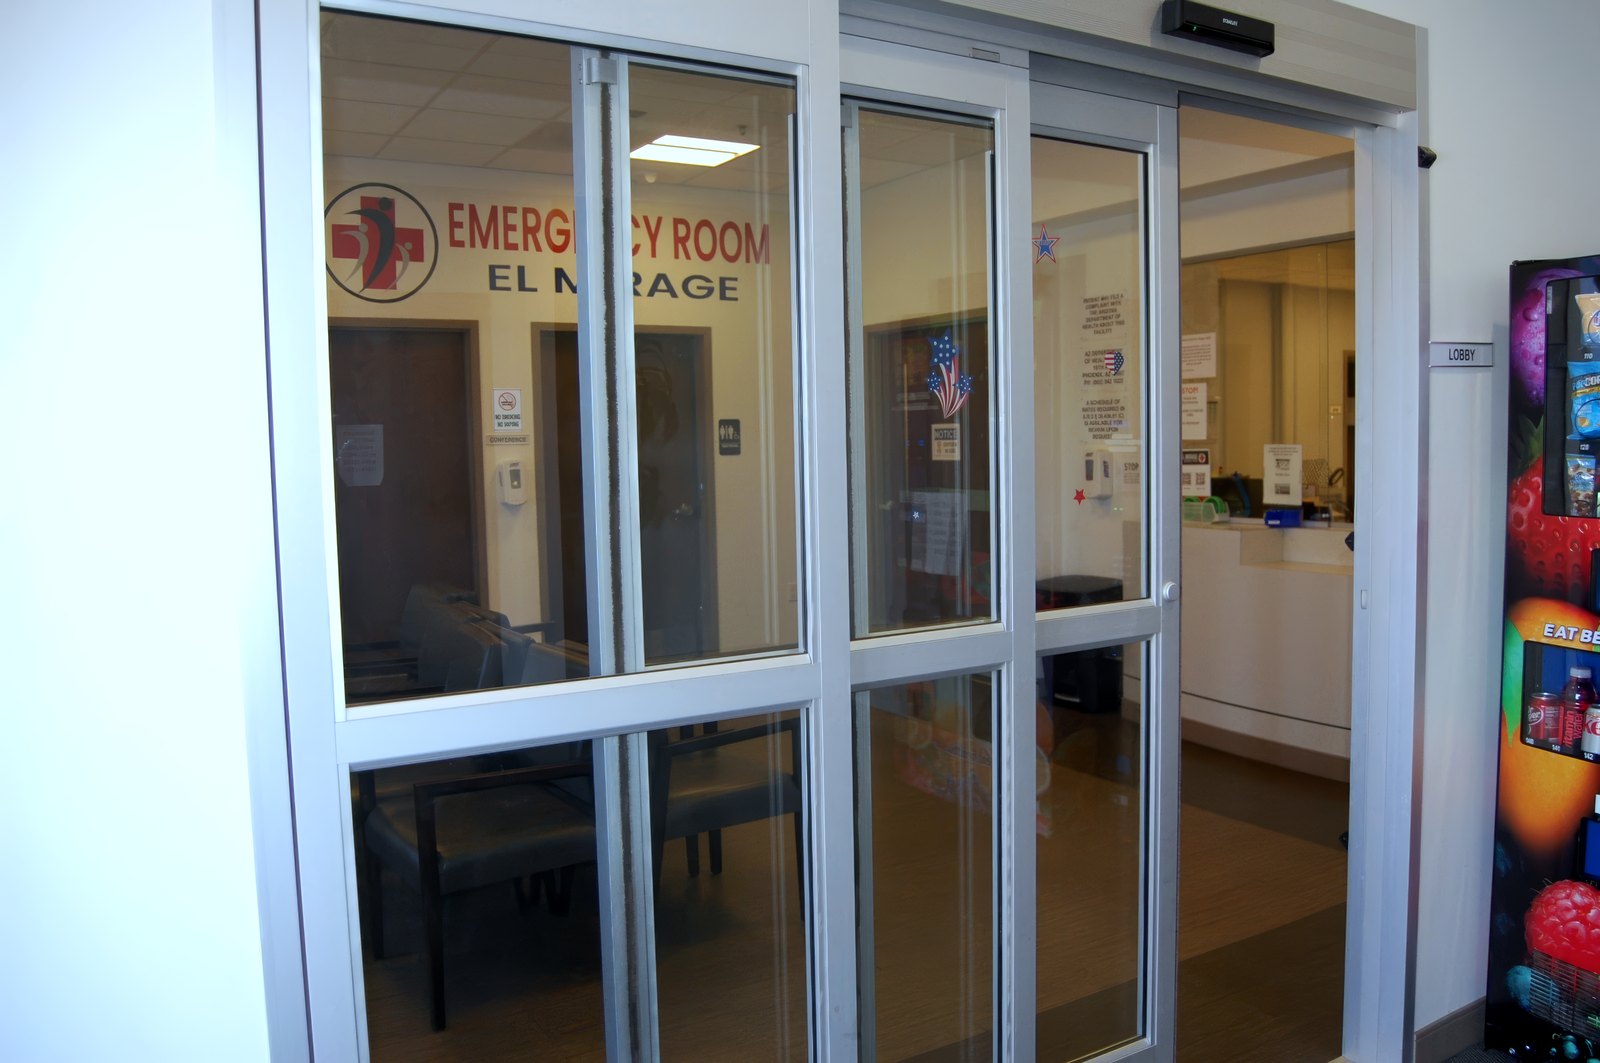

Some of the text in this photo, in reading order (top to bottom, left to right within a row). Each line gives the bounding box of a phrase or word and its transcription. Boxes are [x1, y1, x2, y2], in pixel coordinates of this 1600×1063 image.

[448, 202, 770, 264] EMERGY ROOM
[488, 264, 739, 301] EL MAGE
[1448, 348, 1476, 361] LOBBY
[934, 430, 959, 440] NOTICE
[1124, 462, 1139, 471] STOP
[1543, 624, 1578, 641] EAT
[1584, 752, 1594, 760] 142
